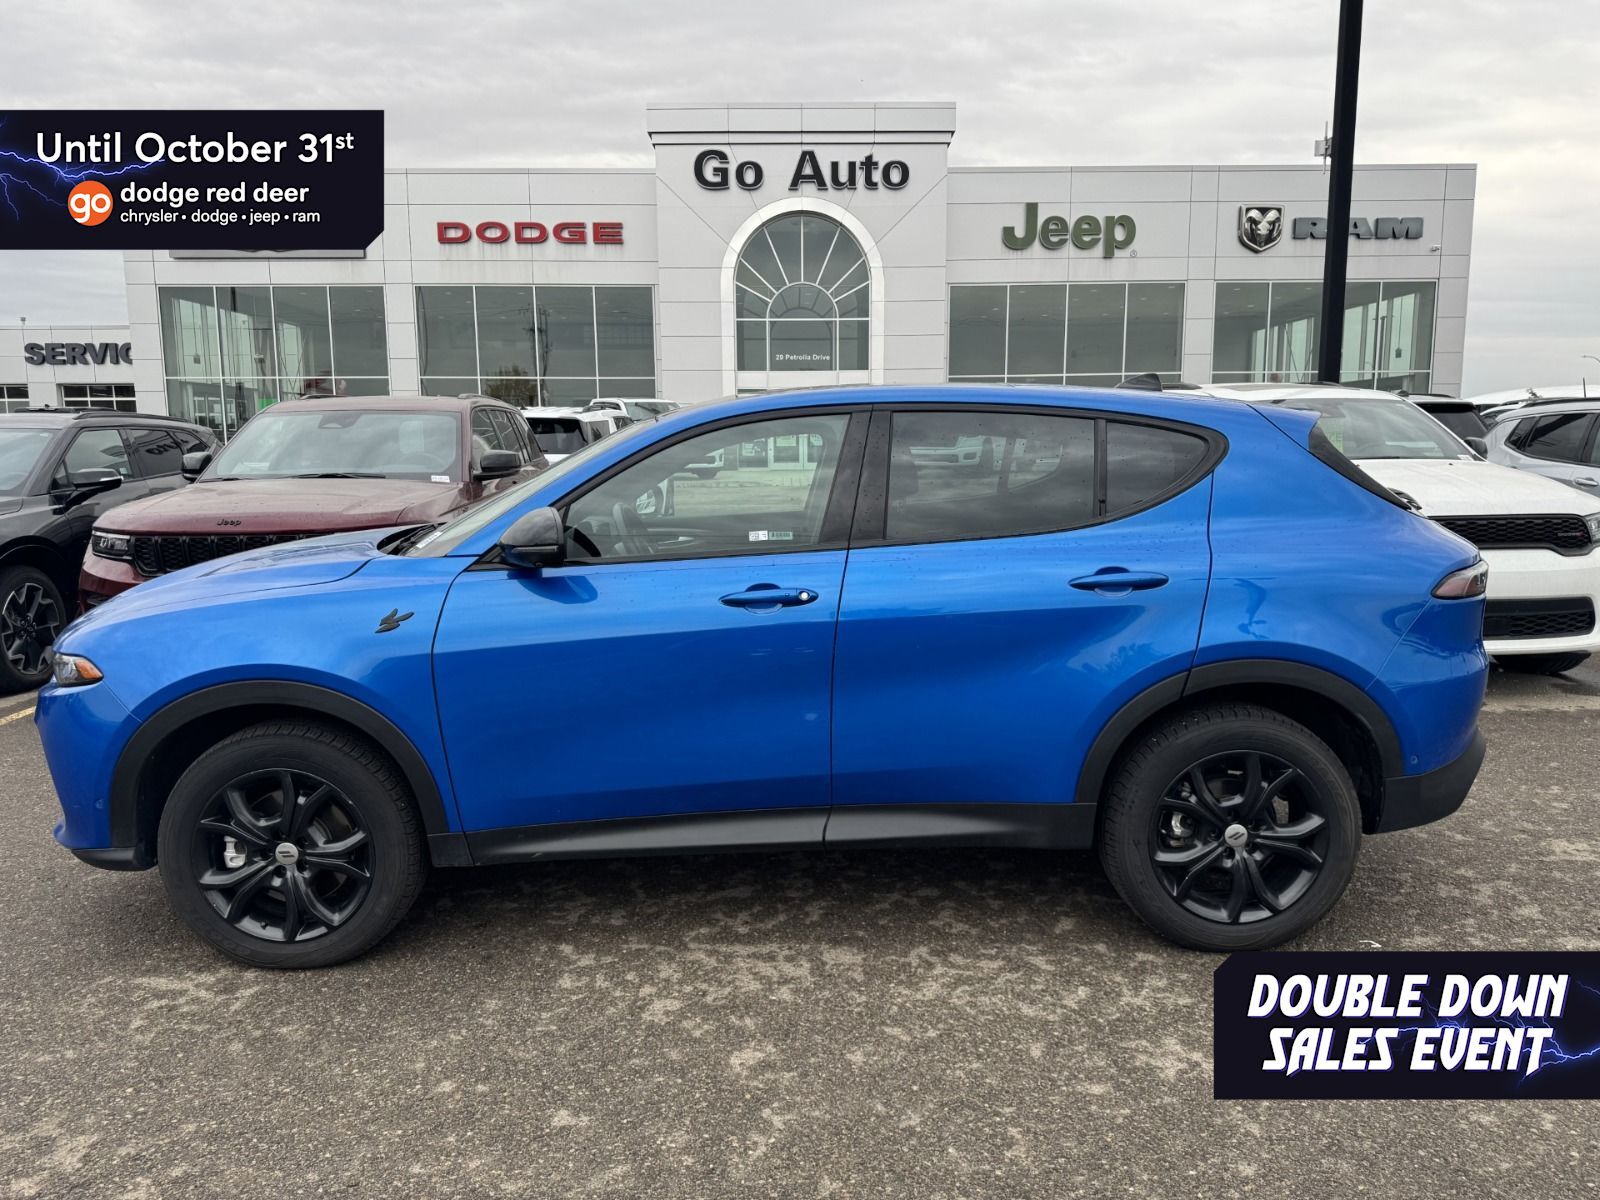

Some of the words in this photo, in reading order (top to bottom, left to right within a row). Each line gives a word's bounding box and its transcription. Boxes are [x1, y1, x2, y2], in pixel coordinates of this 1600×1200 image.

[694, 149, 764, 190] Go
[788, 150, 910, 190] Auto
[437, 221, 624, 244] DODGE
[1002, 202, 1137, 259] Jeep
[1292, 217, 1424, 239] RAM
